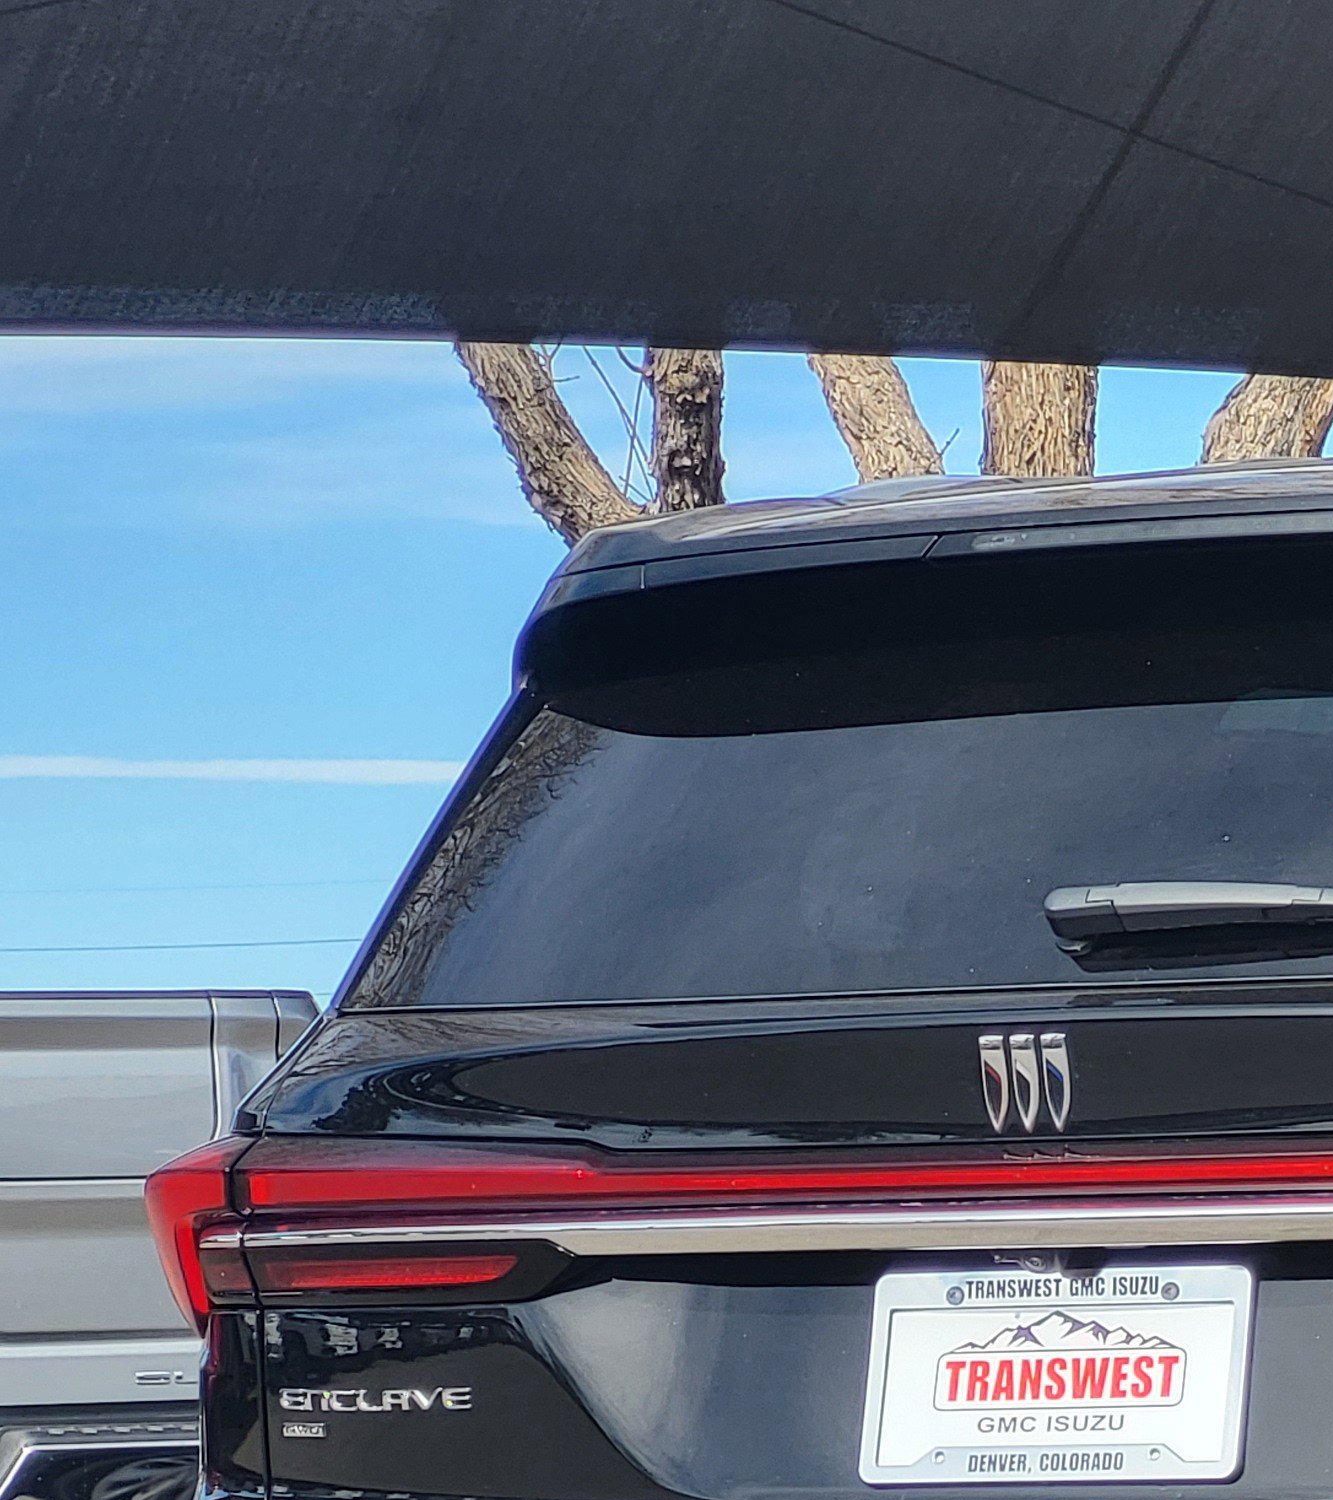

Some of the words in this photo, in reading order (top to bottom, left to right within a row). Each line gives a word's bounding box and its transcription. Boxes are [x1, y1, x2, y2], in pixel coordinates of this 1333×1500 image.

[965, 1278, 1062, 1300] TRANSWEST
[1069, 1277, 1106, 1297] GMC
[1112, 1275, 1161, 1296] ISUZU
[944, 1355, 1181, 1402] TRANSWEST
[278, 1386, 473, 1412] ENCLAVE
[976, 1415, 1038, 1434] GMC
[1045, 1413, 1126, 1433] ISUZU
[967, 1453, 1032, 1475] DENVER,
[1038, 1451, 1125, 1472] COLORADO
